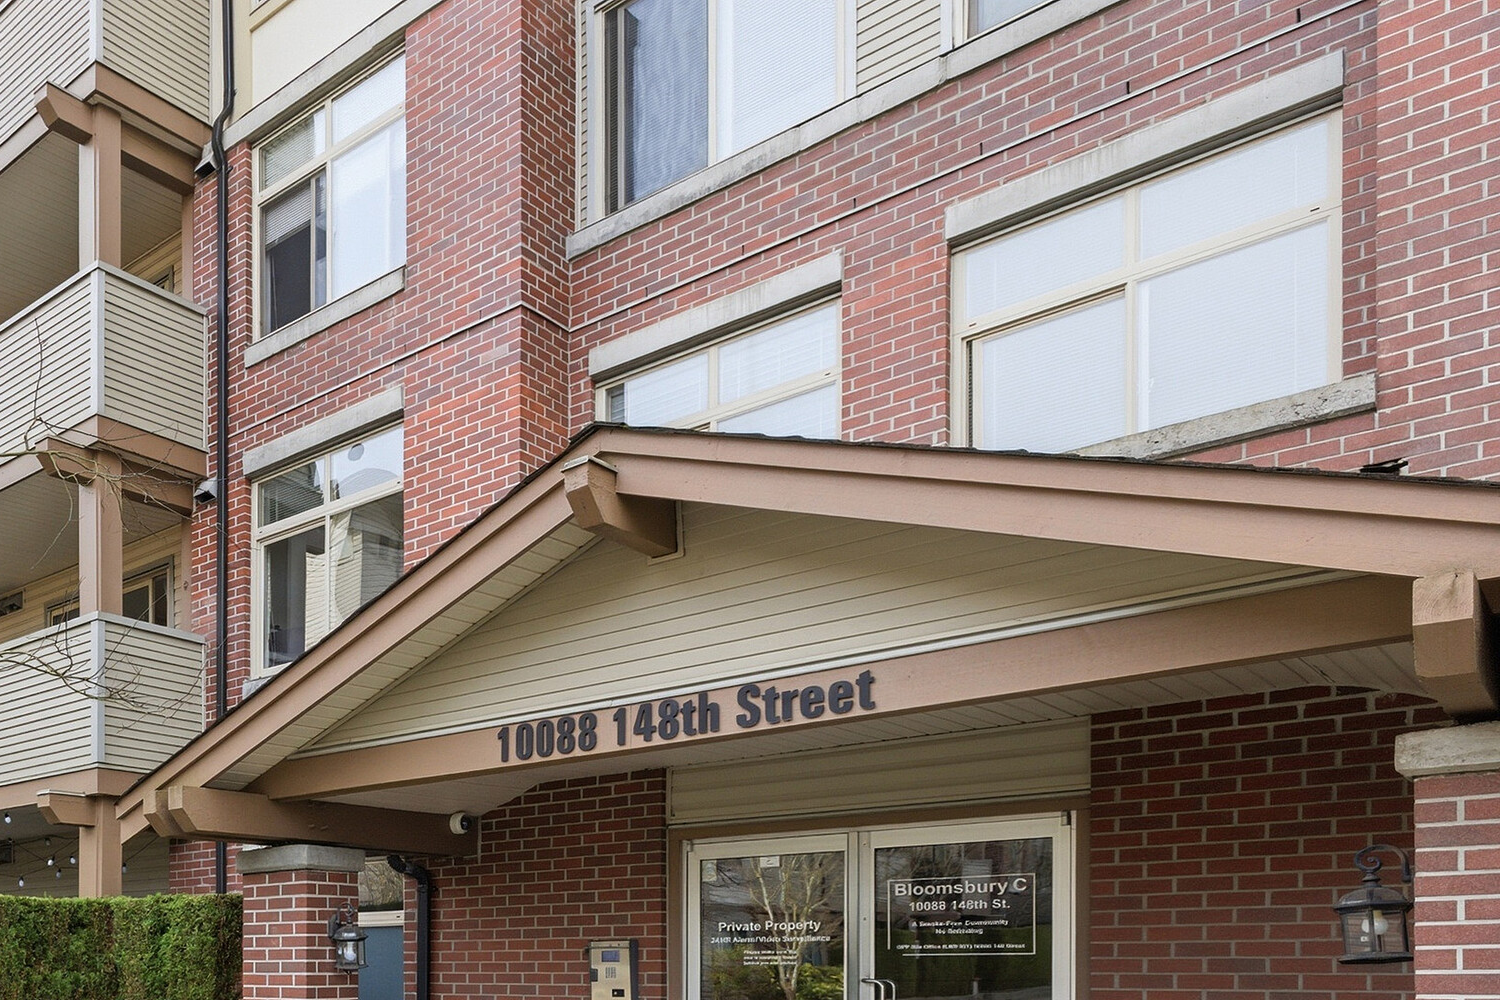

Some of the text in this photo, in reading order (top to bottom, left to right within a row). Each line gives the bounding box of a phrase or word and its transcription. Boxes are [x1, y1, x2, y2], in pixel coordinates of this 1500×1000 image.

[497, 669, 876, 764] 10088 148th Street
[894, 878, 1027, 896] Bloomsbury C
[991, 899, 1011, 909] St.
[718, 920, 821, 932] Private Property
